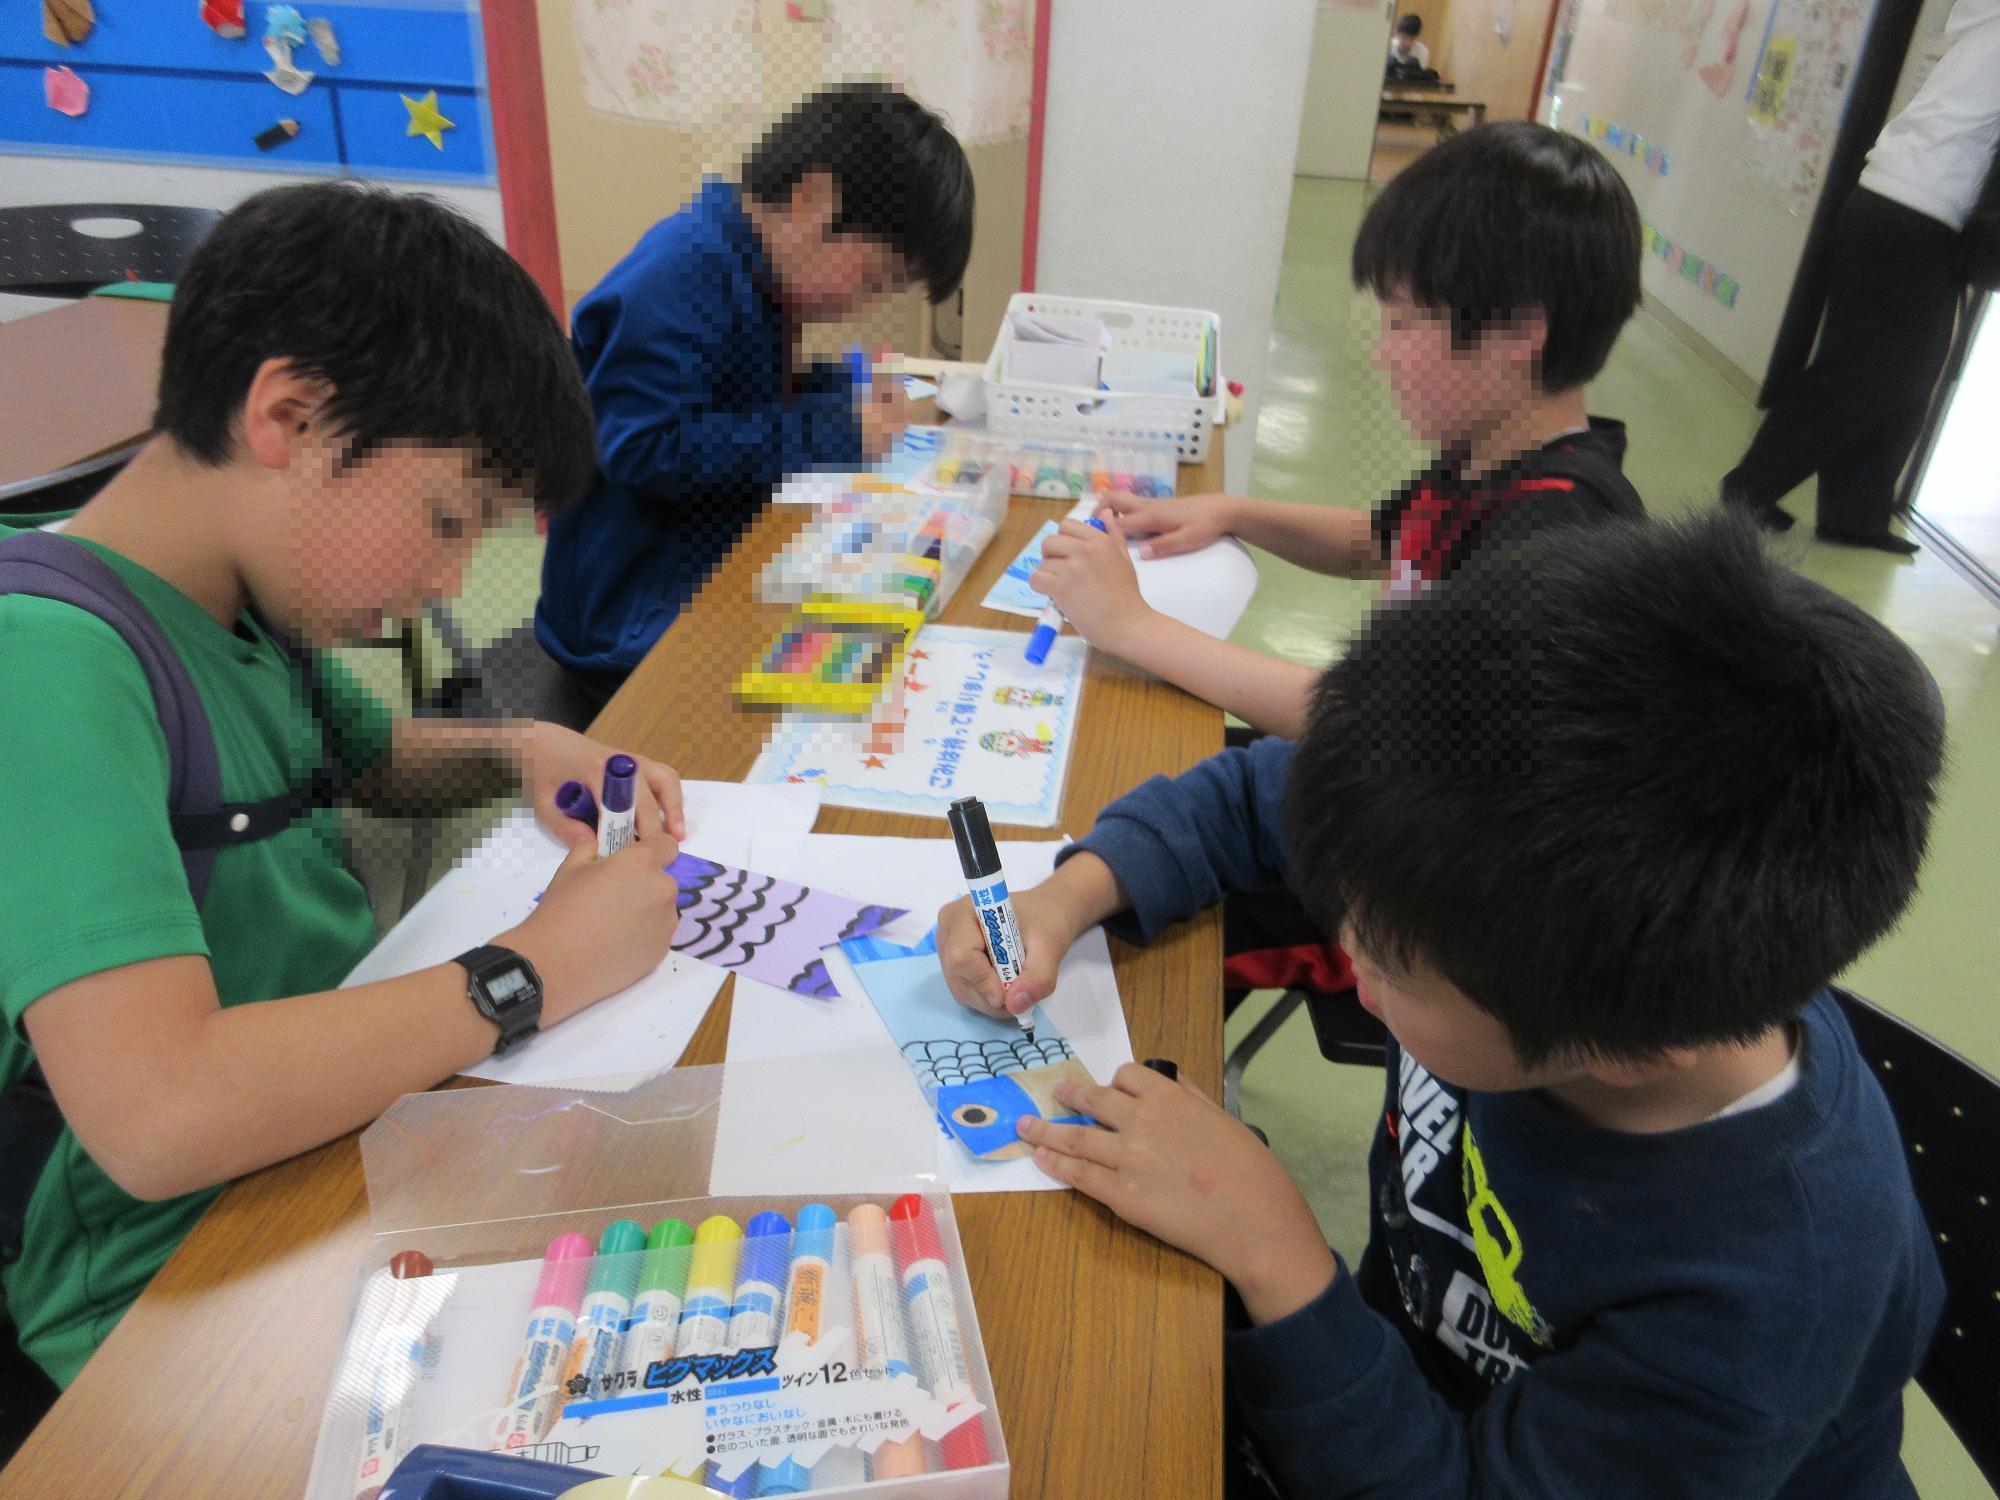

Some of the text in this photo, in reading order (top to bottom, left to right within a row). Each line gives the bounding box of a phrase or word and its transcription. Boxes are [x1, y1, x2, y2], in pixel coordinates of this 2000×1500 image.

[601, 1370, 638, 1392] サクラ
[643, 1346, 778, 1389] ピグマックス
[670, 1388, 702, 1405] 水性
